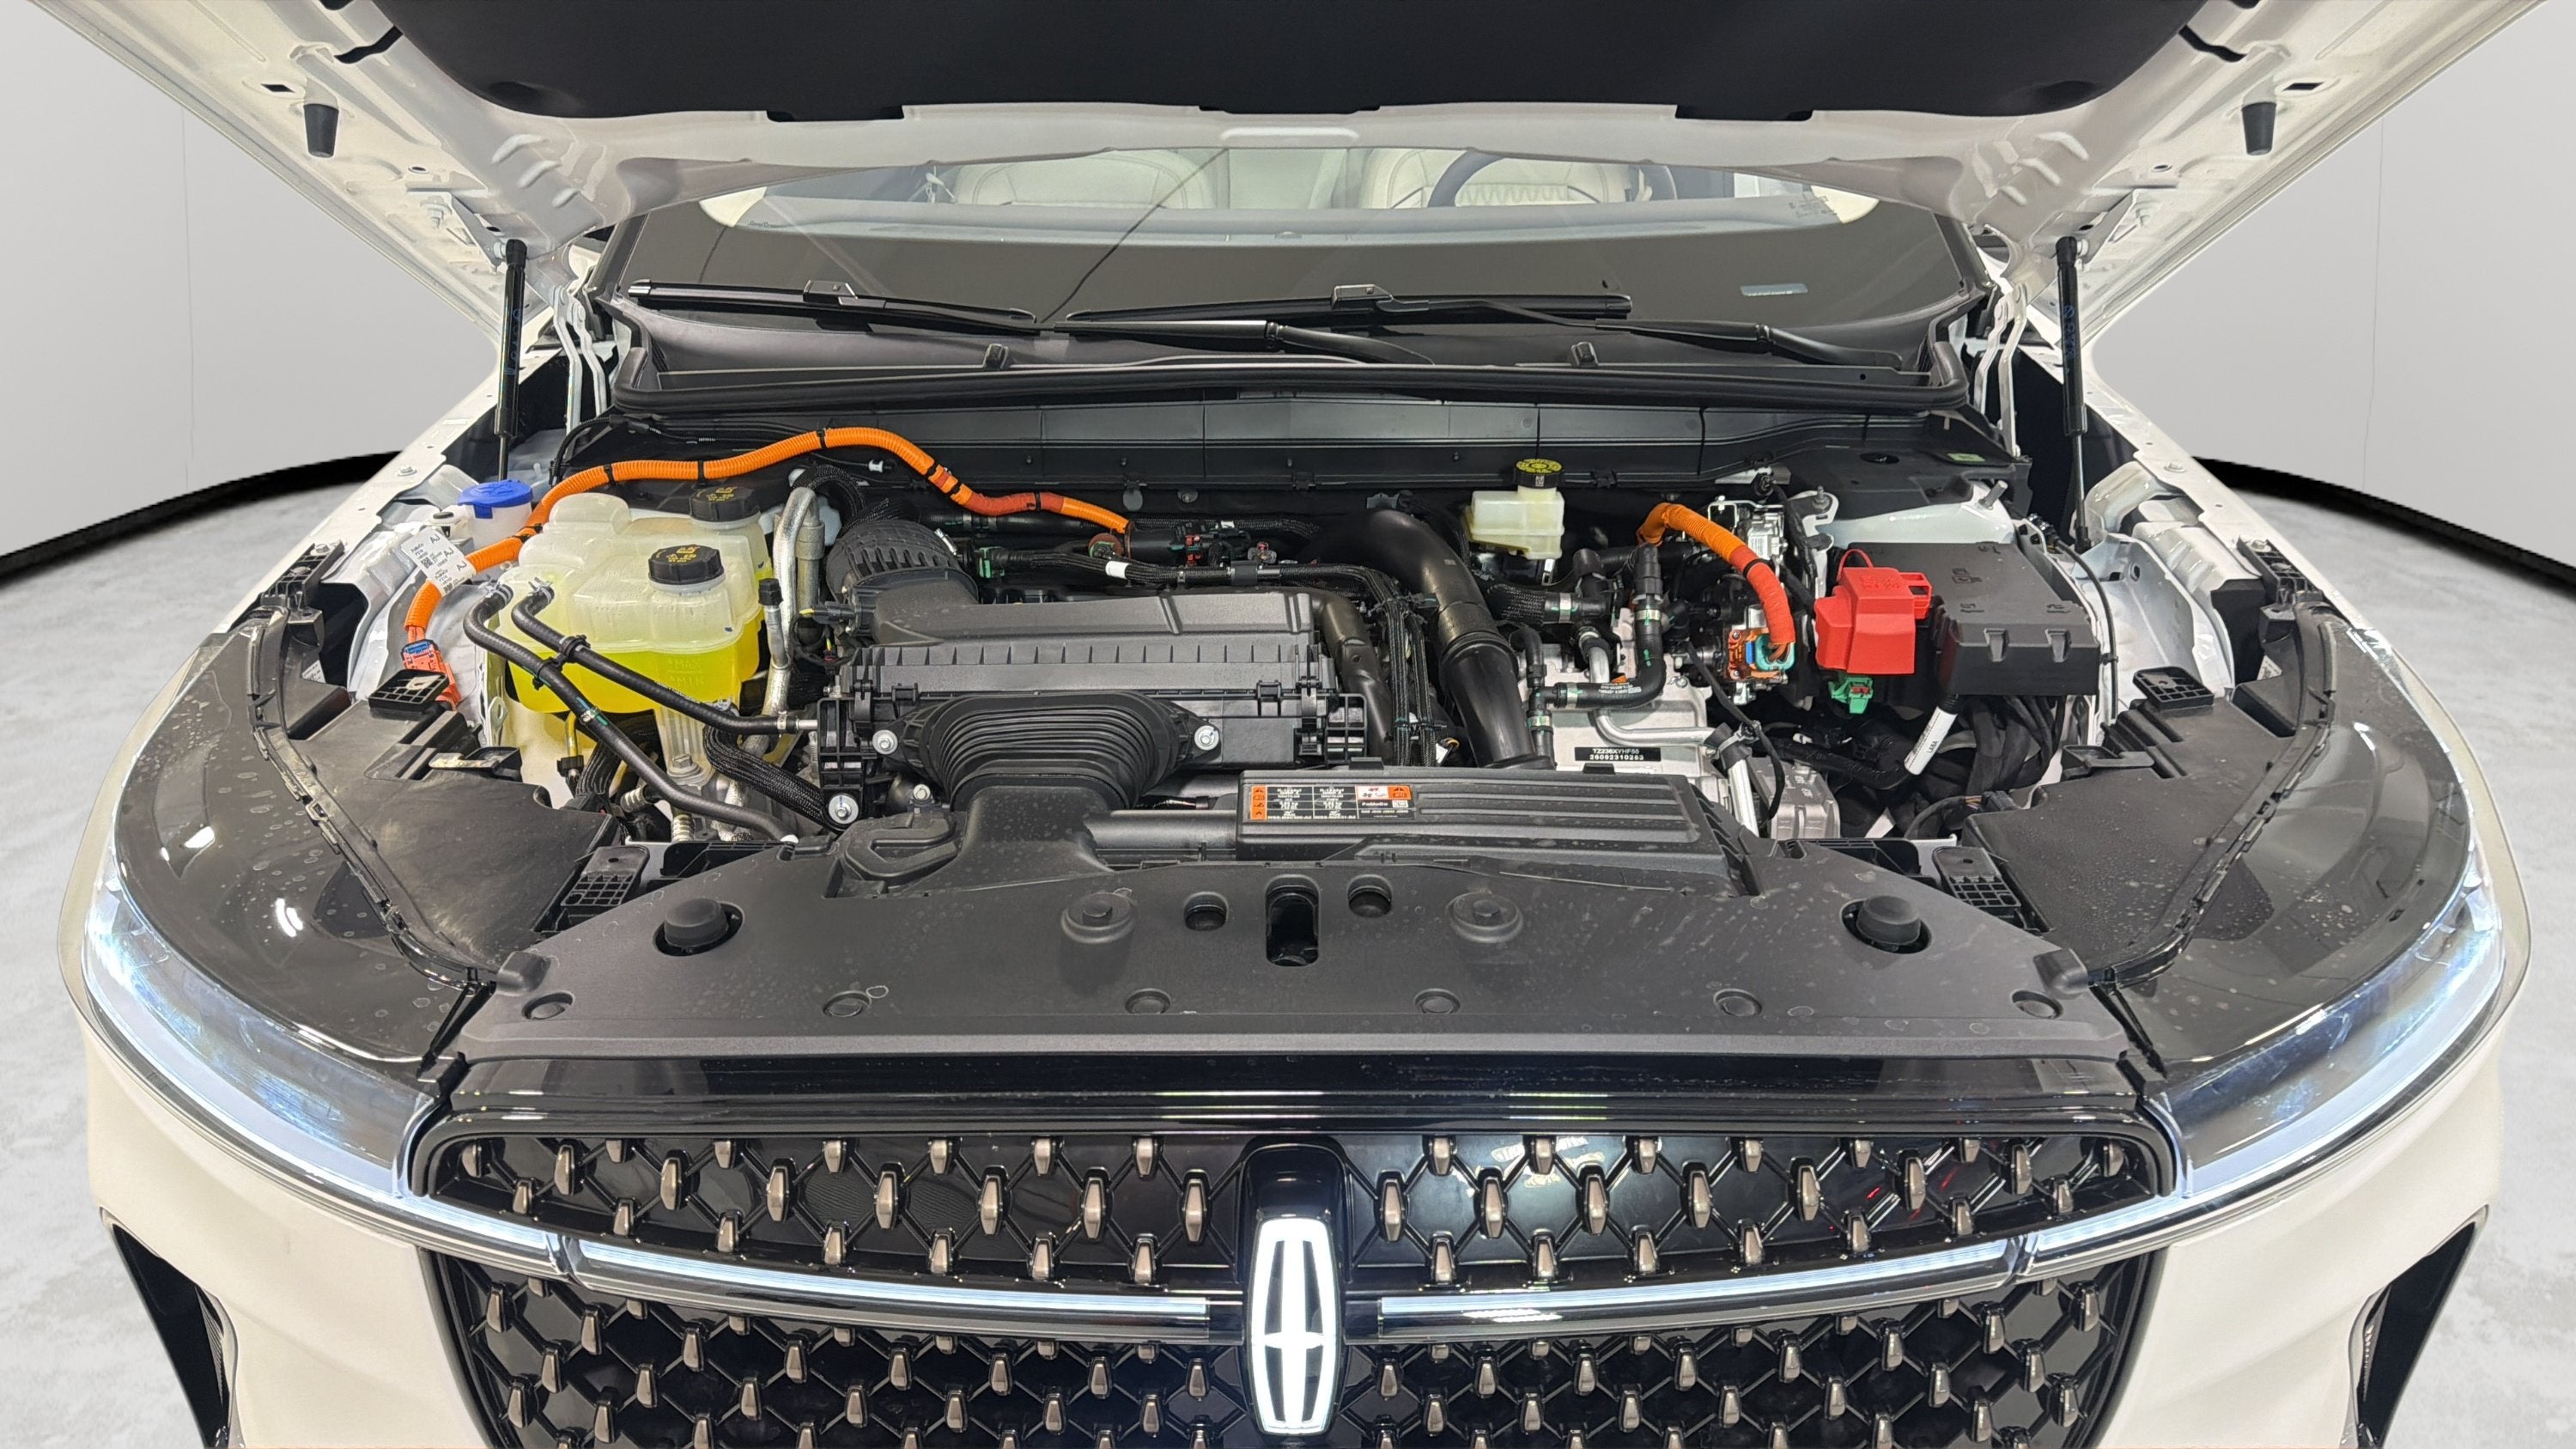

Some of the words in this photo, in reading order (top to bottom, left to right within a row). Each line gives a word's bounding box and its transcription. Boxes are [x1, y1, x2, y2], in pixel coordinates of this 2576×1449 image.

[429, 533, 440, 545] AJ
[443, 546, 454, 557] AJ
[456, 560, 468, 572] AJ
